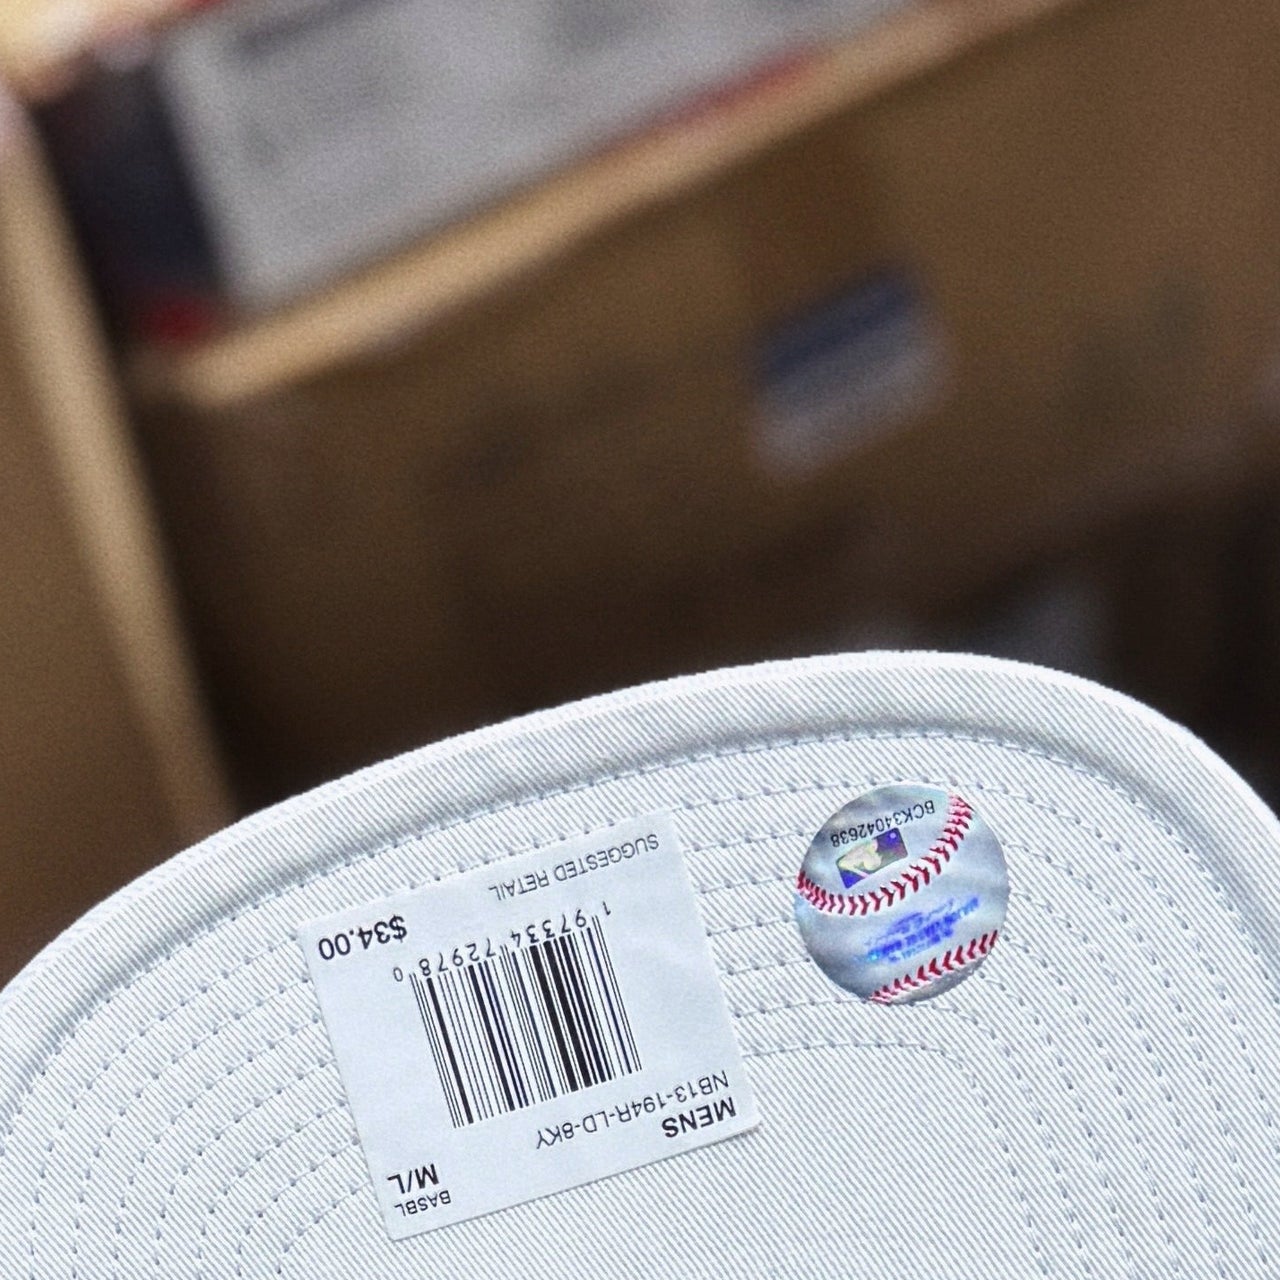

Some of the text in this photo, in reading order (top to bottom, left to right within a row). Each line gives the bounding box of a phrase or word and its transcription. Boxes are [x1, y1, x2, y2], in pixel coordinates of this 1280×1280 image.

[829, 800, 935, 847] BCK34042638
[488, 833, 659, 901] SUGGESTED RETAIL
[318, 914, 408, 961] $34.00
[536, 1070, 729, 1150] NB13-194R-LD-8KY
[661, 1096, 736, 1138] MENS
[386, 1163, 439, 1194] M/L
[394, 1189, 452, 1217] BASBL
